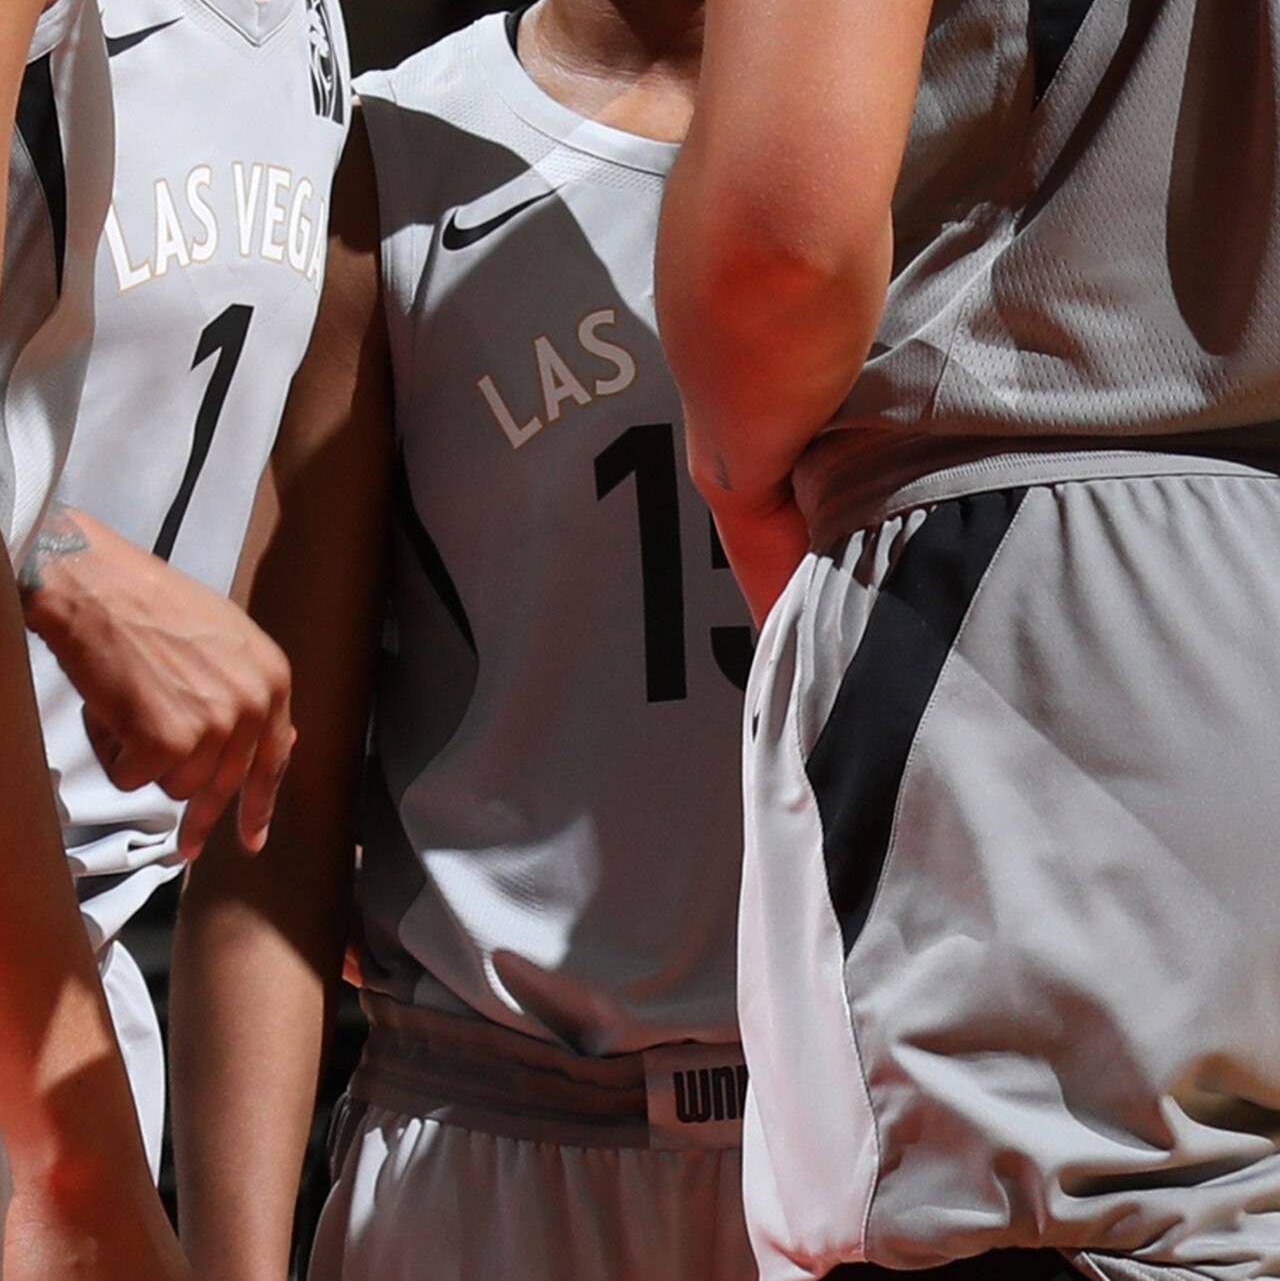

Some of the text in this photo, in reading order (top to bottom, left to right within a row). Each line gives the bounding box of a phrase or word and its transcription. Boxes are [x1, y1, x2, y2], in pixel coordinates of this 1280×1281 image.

[103, 164, 219, 293] LAS
[151, 303, 254, 563] 1
[477, 308, 637, 450] LAS
